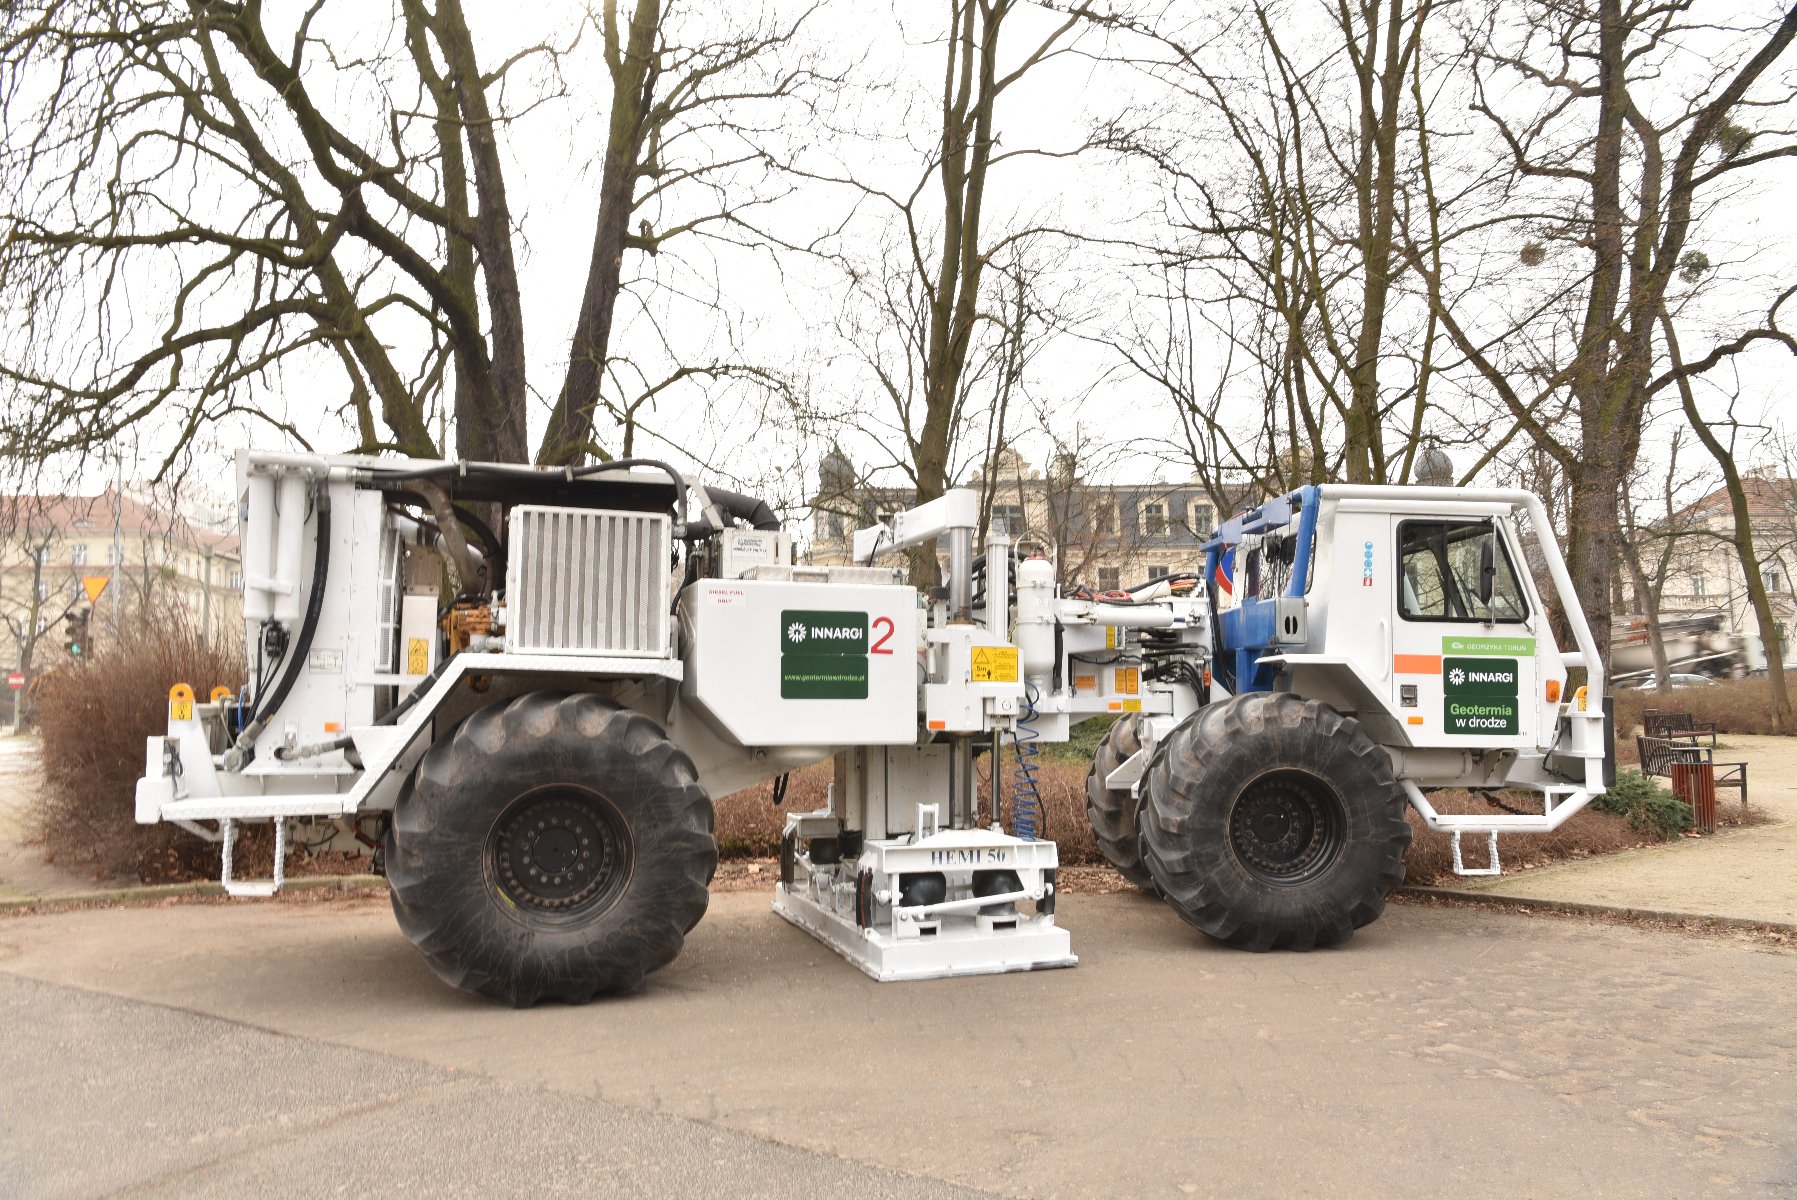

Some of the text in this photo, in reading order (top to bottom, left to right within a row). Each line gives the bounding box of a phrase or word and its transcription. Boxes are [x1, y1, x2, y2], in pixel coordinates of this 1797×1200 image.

[811, 626, 863, 640] INNARGI
[870, 616, 895, 655] 2
[1468, 672, 1513, 683] INNARGI
[1450, 703, 1512, 716] Geotermia
[1455, 716, 1507, 728] w drodze
[931, 848, 1005, 865] HEMI 50
